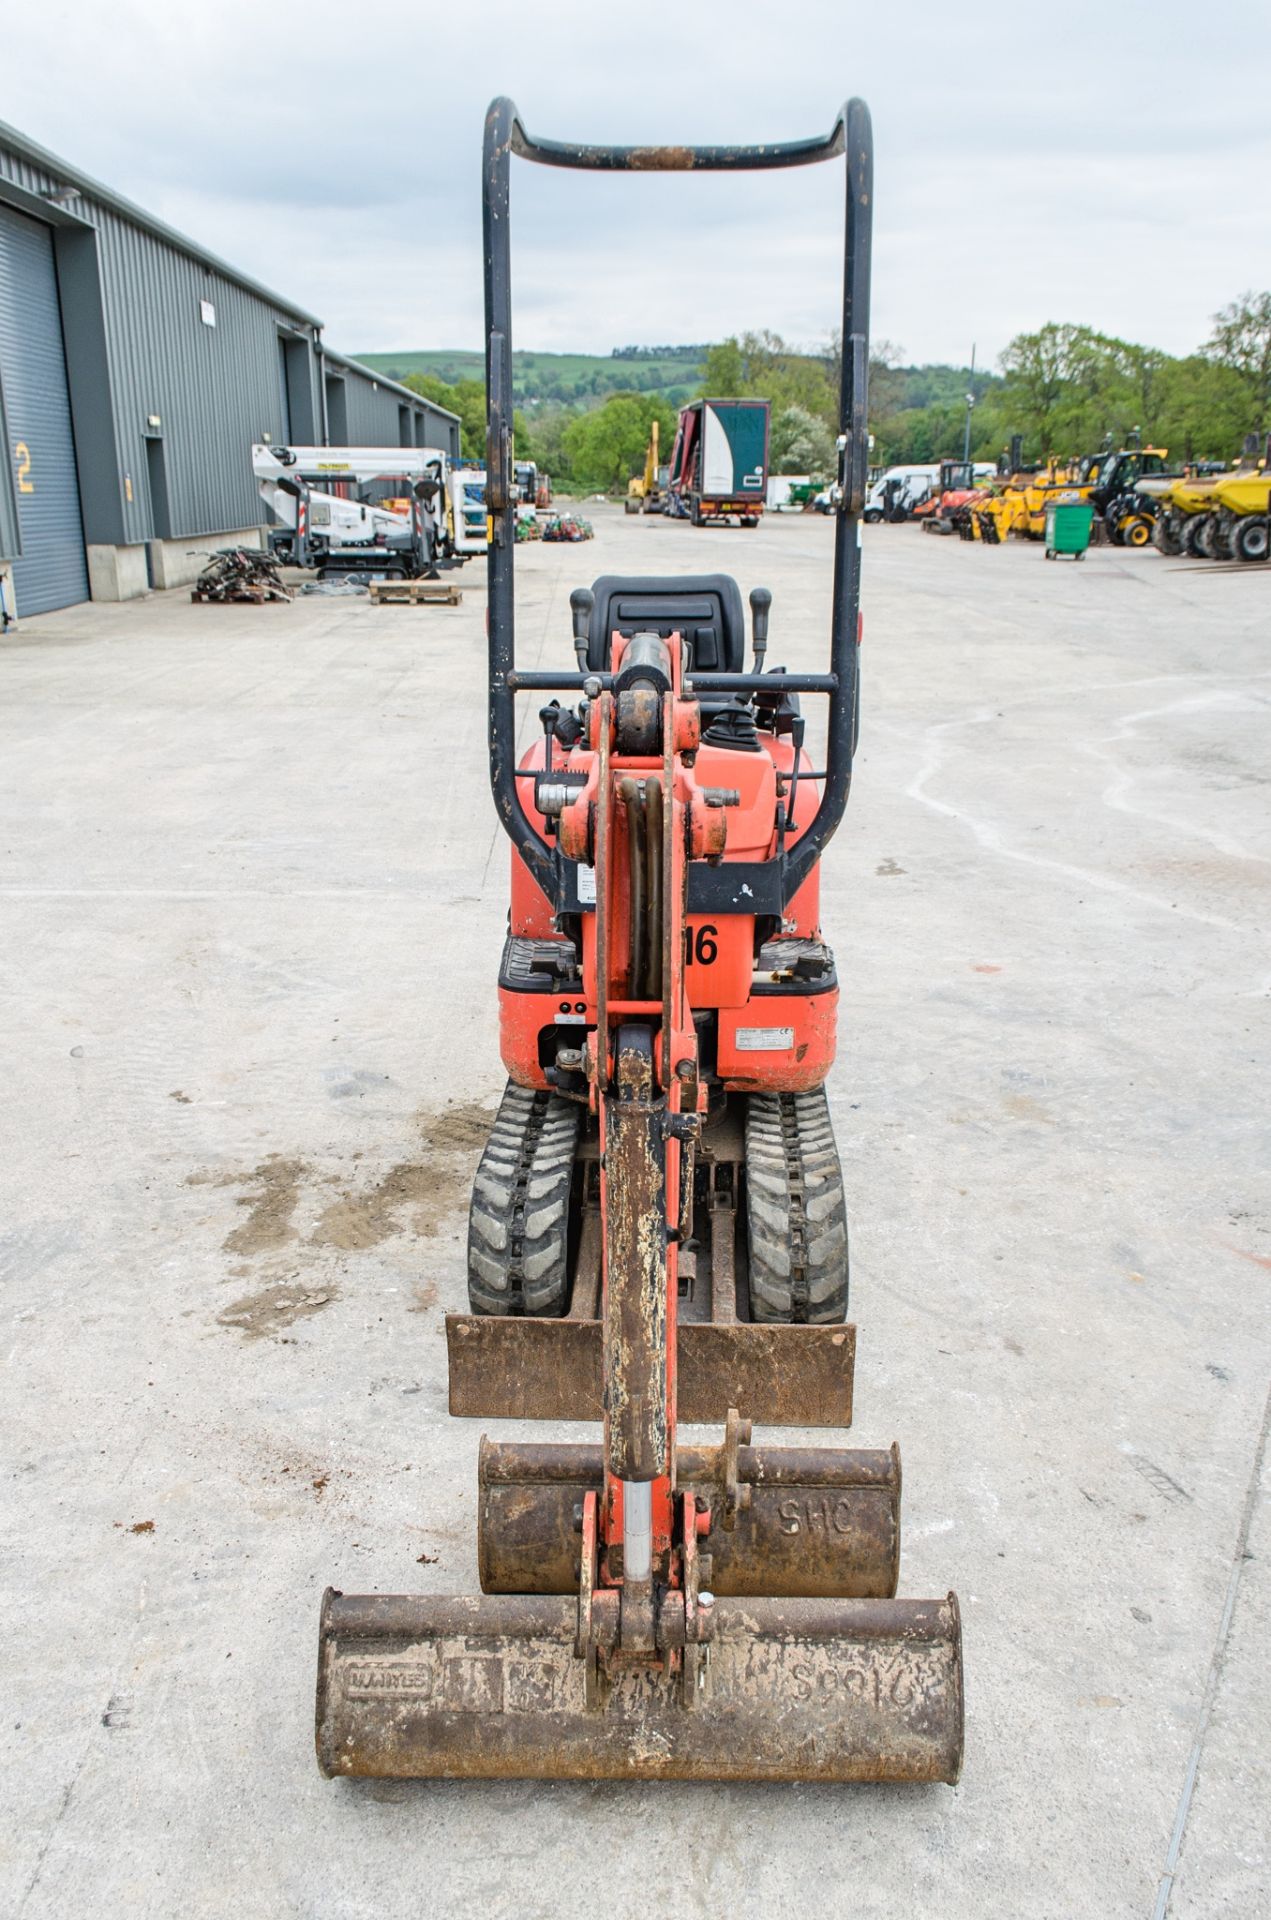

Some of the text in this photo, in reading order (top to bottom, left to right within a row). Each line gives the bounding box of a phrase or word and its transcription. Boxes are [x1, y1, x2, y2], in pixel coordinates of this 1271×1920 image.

[16, 441, 34, 493] 2
[685, 924, 718, 966] 16
[778, 1498, 852, 1535] SHC
